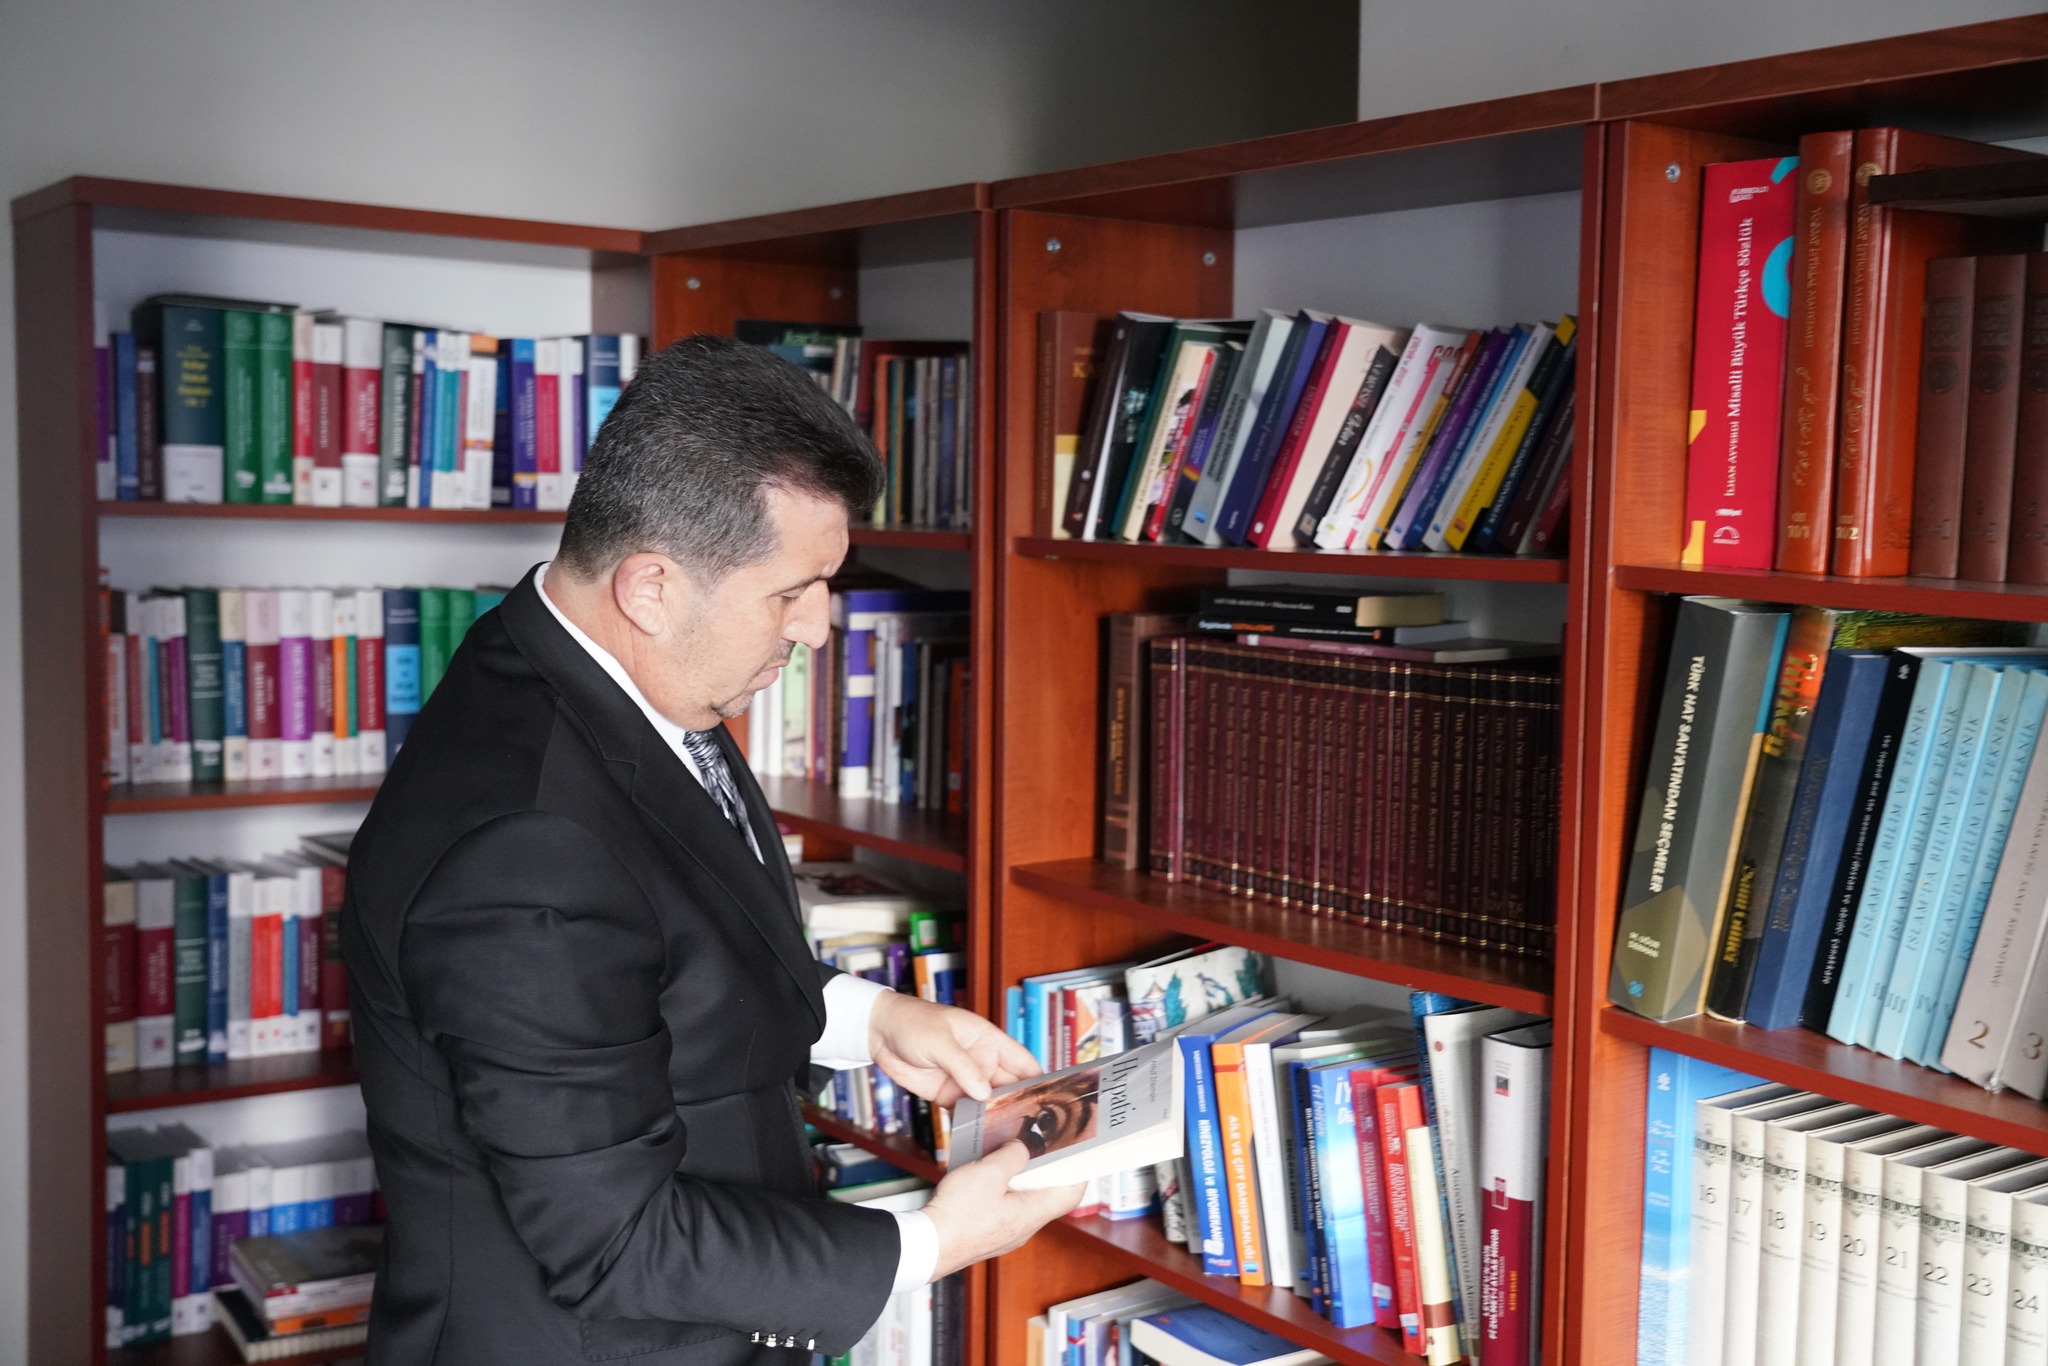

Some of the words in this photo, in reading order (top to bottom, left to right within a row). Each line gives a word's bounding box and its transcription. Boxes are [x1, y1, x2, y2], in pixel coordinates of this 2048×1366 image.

[1737, 216, 1753, 267] Sözlük
[1733, 269, 1752, 320] Türkçe
[1730, 321, 1748, 367] Büyük
[1726, 369, 1743, 418] Misalli
[1686, 654, 1707, 692] TÜRK
[1680, 692, 1698, 722] HAT
[1661, 722, 1692, 820] SAN'ATINDAN
[1647, 820, 1674, 892] SEÇMELER
[1968, 1020, 1990, 1050] 2
[2026, 1032, 2044, 1061] 3
[1102, 1056, 1139, 1129] Hypatia
[1226, 1114, 1241, 1139] AİLE
[1195, 1118, 1218, 1174] KİNEZYOLOJİ
[1230, 1140, 1242, 1155] VE
[1230, 1156, 1246, 1180] ÇİFT
[1699, 1184, 1717, 1204] 16
[1733, 1197, 1752, 1216] 17
[1203, 1187, 1225, 1241] BİYOMEKANİ
[1232, 1181, 1256, 1260] DANIŞMANLIĞI
[1767, 1208, 1786, 1230] 18
[1808, 1221, 1827, 1241] 19
[1842, 1234, 1867, 1257] 20
[1885, 1246, 1908, 1269] 21
[1923, 1262, 1949, 1286] 22
[1966, 1273, 1993, 1297] 23
[2012, 1289, 2039, 1314] 24
